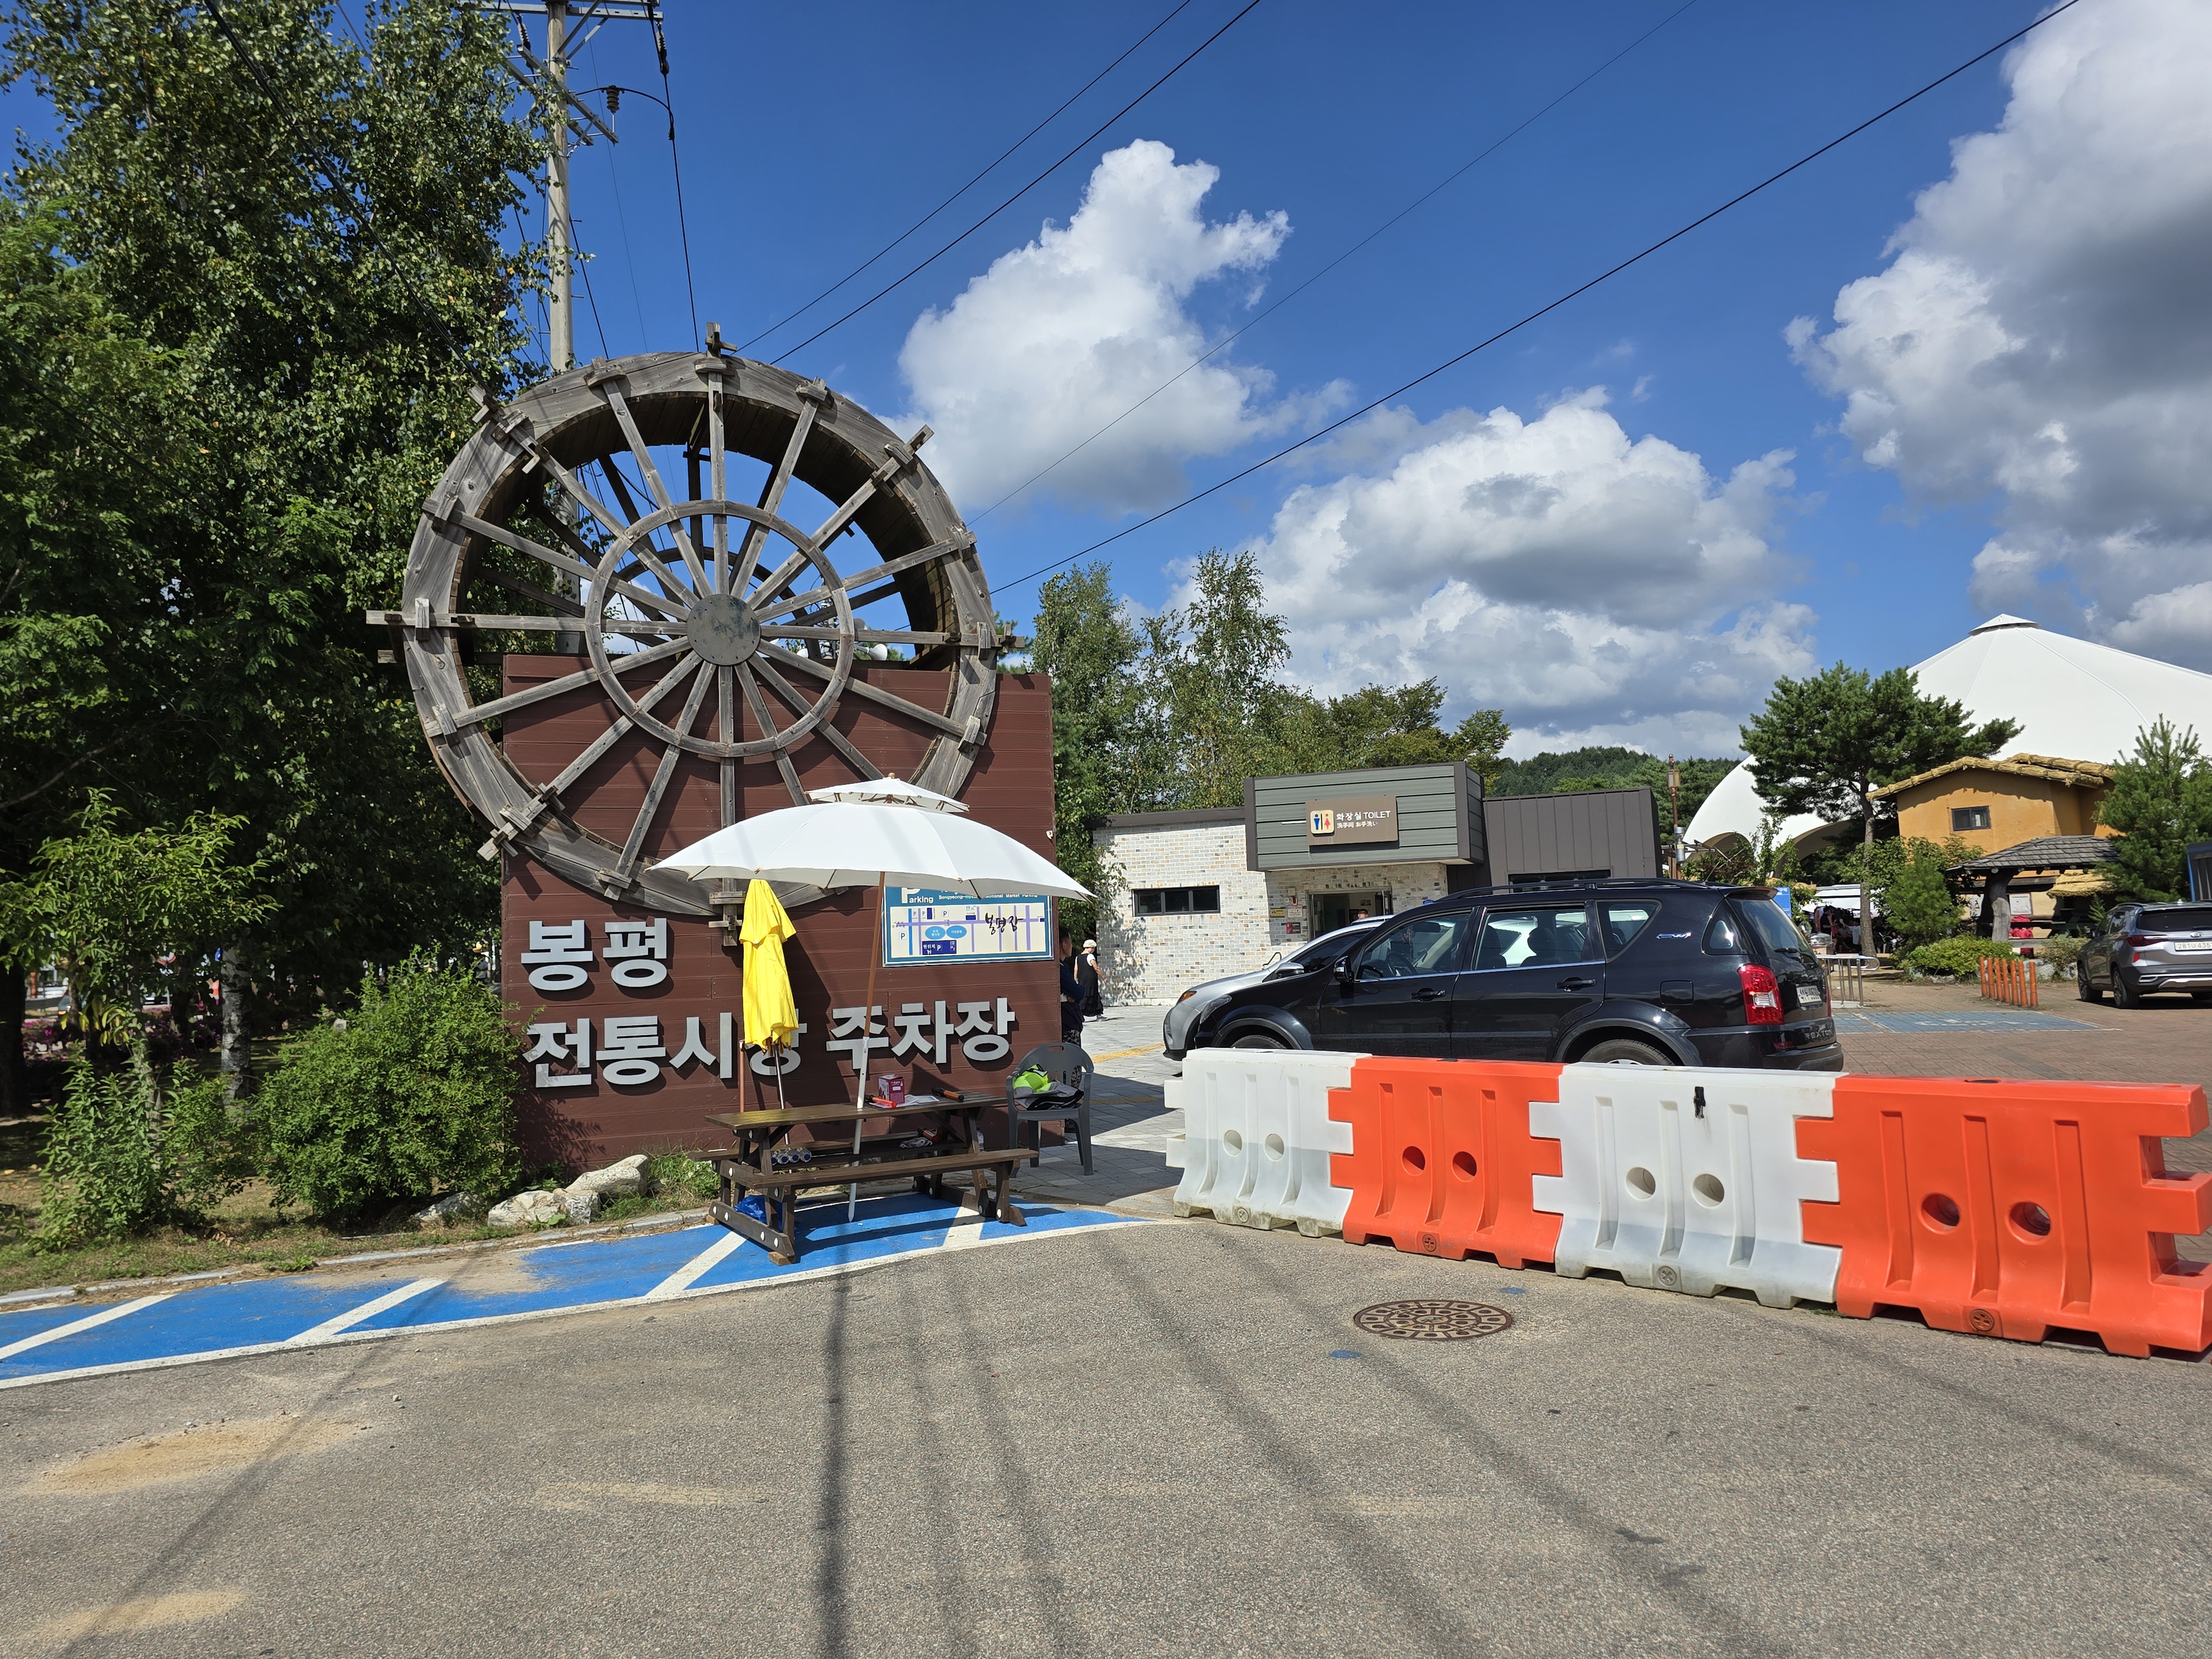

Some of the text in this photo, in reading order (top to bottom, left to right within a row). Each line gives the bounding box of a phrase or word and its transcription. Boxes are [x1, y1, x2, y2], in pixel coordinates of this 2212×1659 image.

[1336, 811, 1391, 821] 화장실 TOILET
[985, 912, 1024, 935] 봉평장
[521, 918, 667, 990] 봉평
[826, 998, 1015, 1069] 주차장
